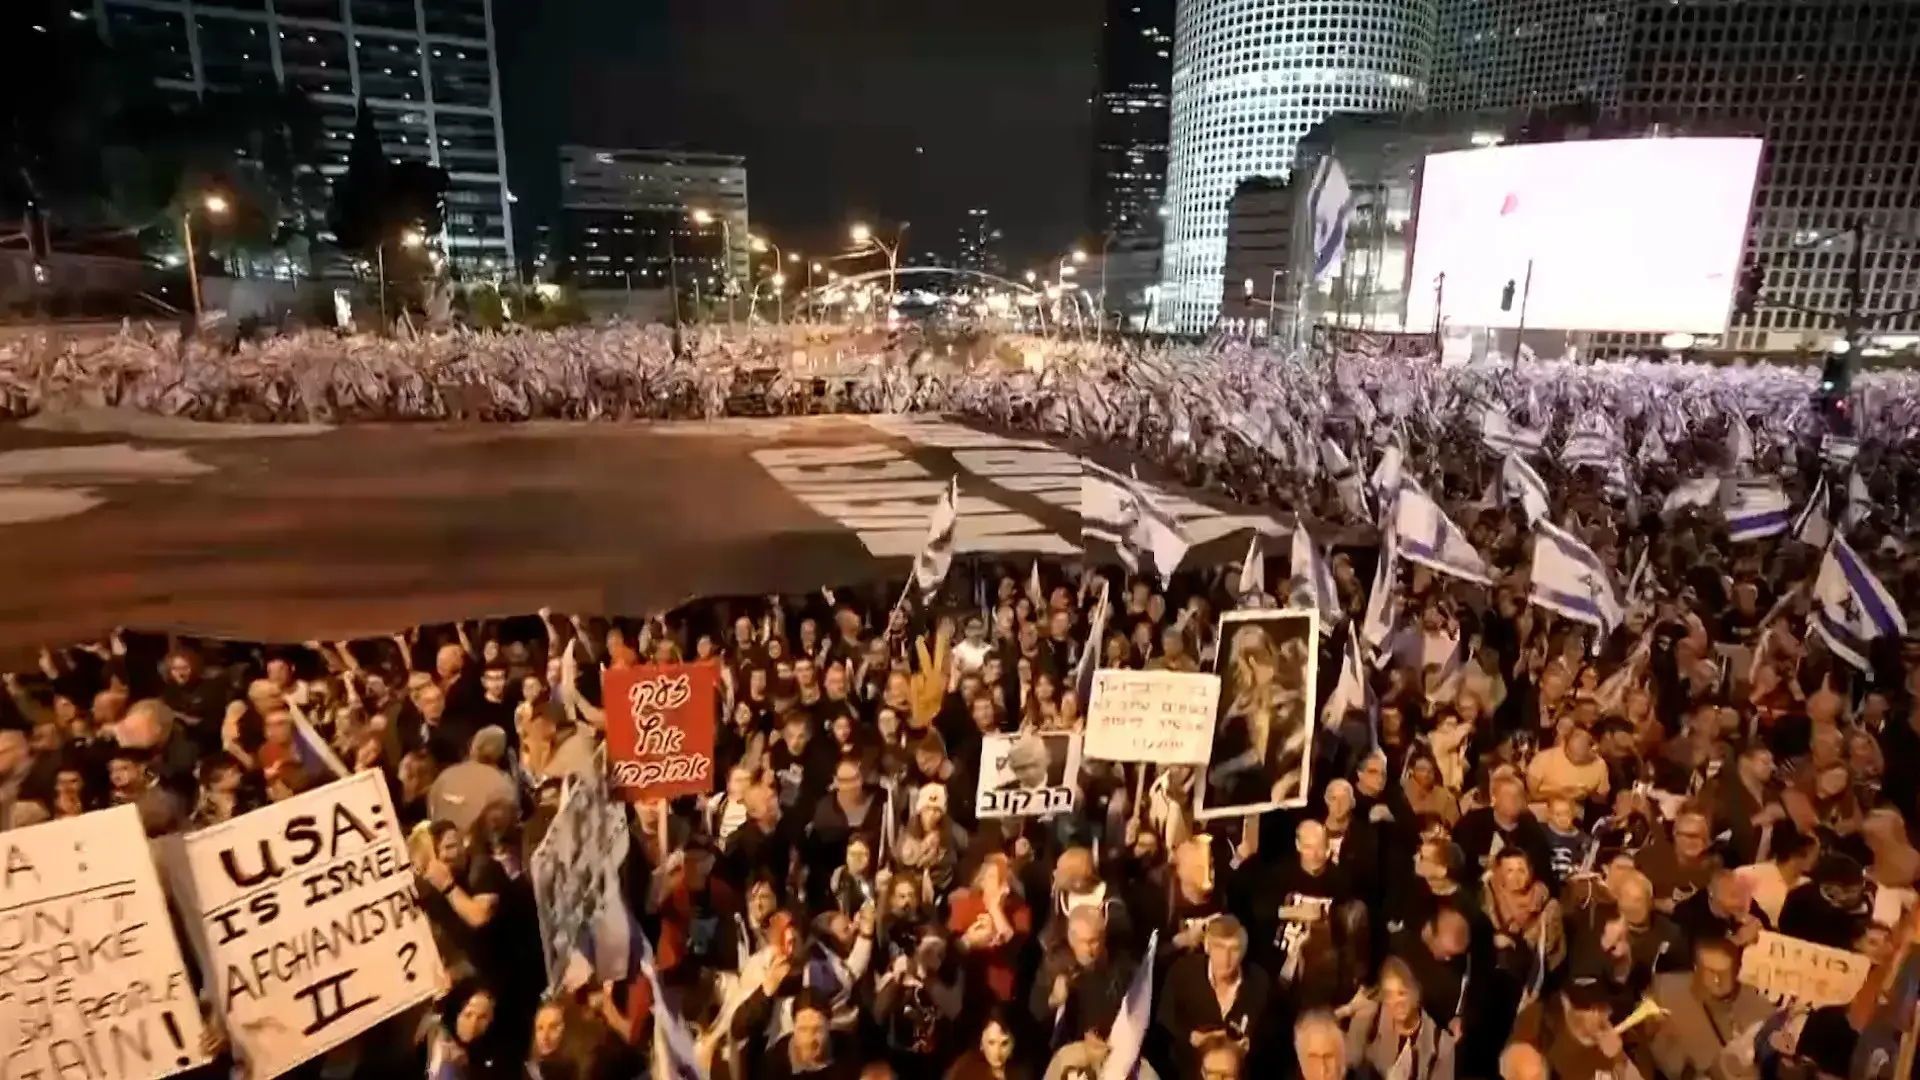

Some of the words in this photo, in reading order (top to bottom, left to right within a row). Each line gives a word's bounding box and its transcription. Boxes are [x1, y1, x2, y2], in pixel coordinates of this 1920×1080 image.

[636, 714, 685, 755] ארץ
[980, 787, 1073, 814] הרקוב
[213, 892, 280, 944] IS
[303, 846, 412, 908] ISRAEL
[294, 967, 381, 1036] II
[397, 941, 418, 982] ?
